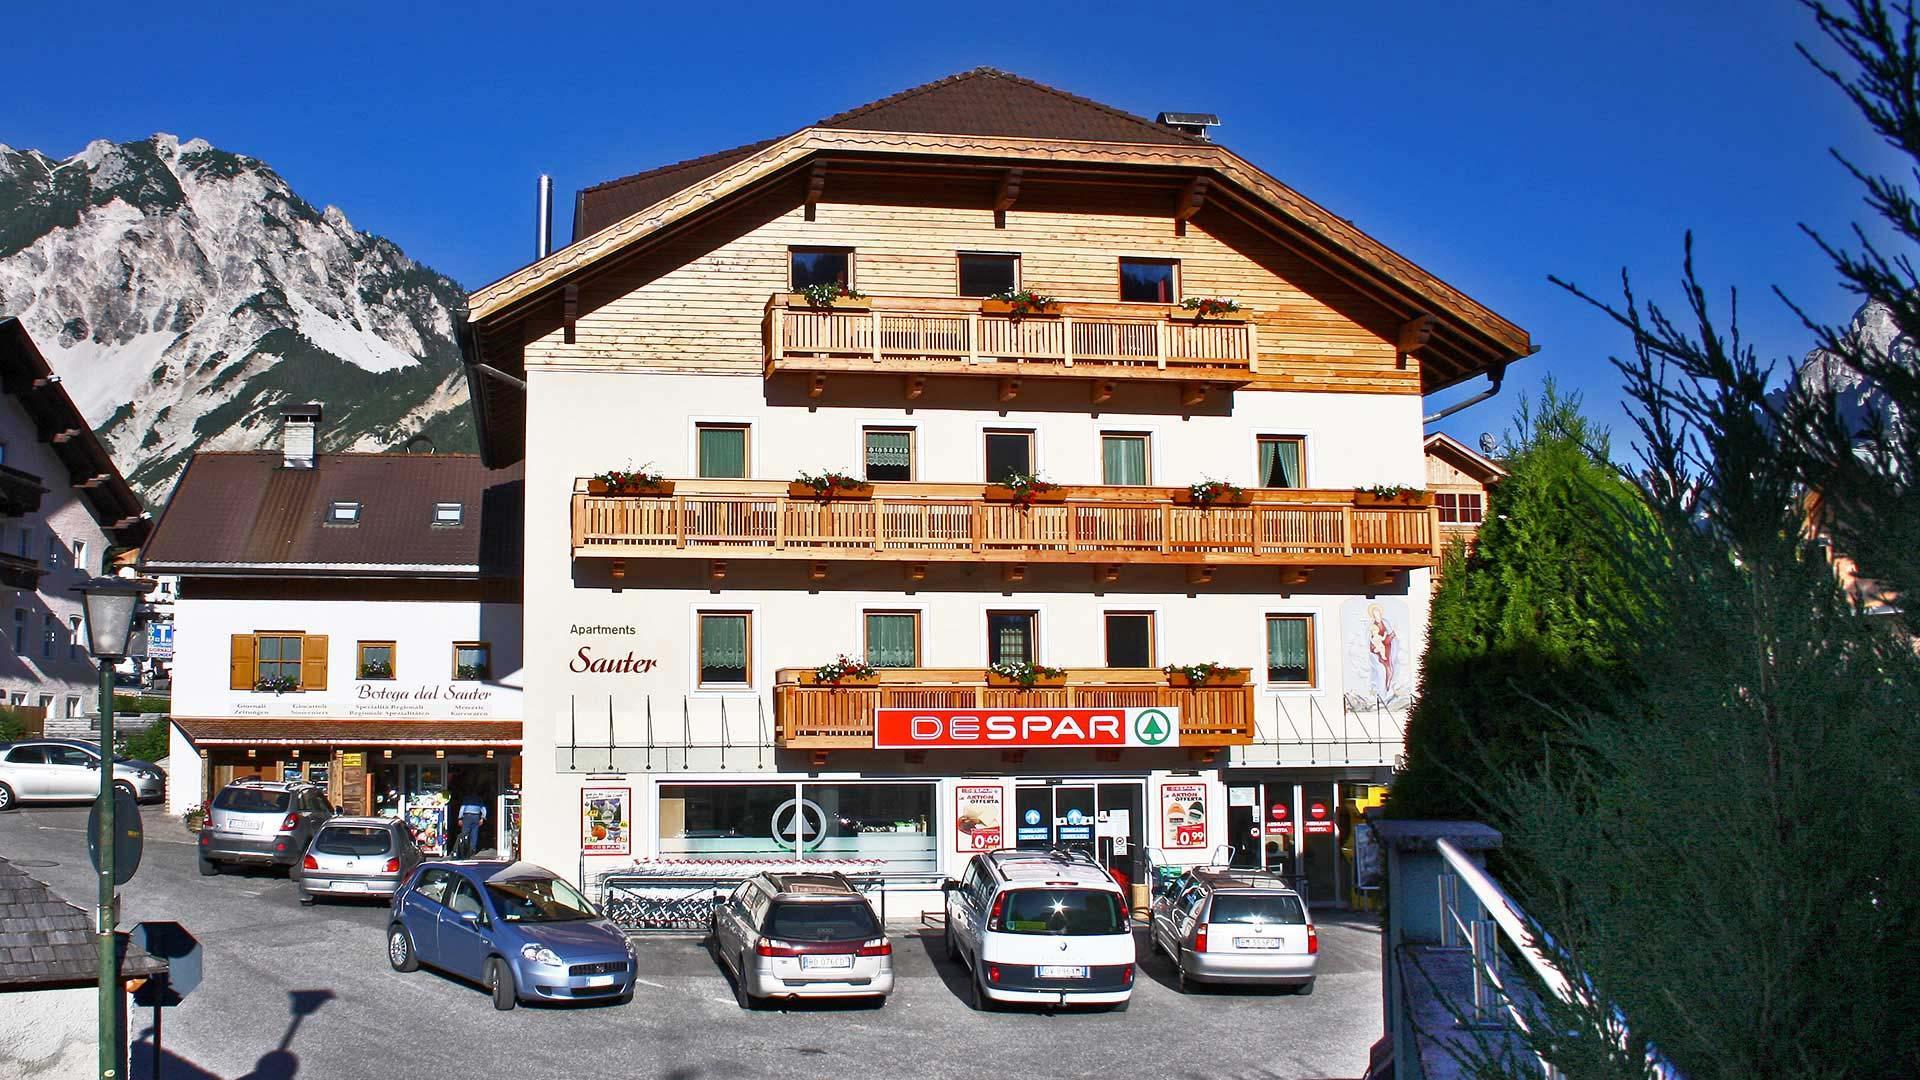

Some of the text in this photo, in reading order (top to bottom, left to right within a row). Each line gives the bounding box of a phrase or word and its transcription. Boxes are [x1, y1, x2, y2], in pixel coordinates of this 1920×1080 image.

[570, 624, 636, 636] Apartments
[569, 646, 657, 673] Sauter
[356, 683, 492, 701] Botega dal Sauter
[911, 715, 1119, 740] DESPAR
